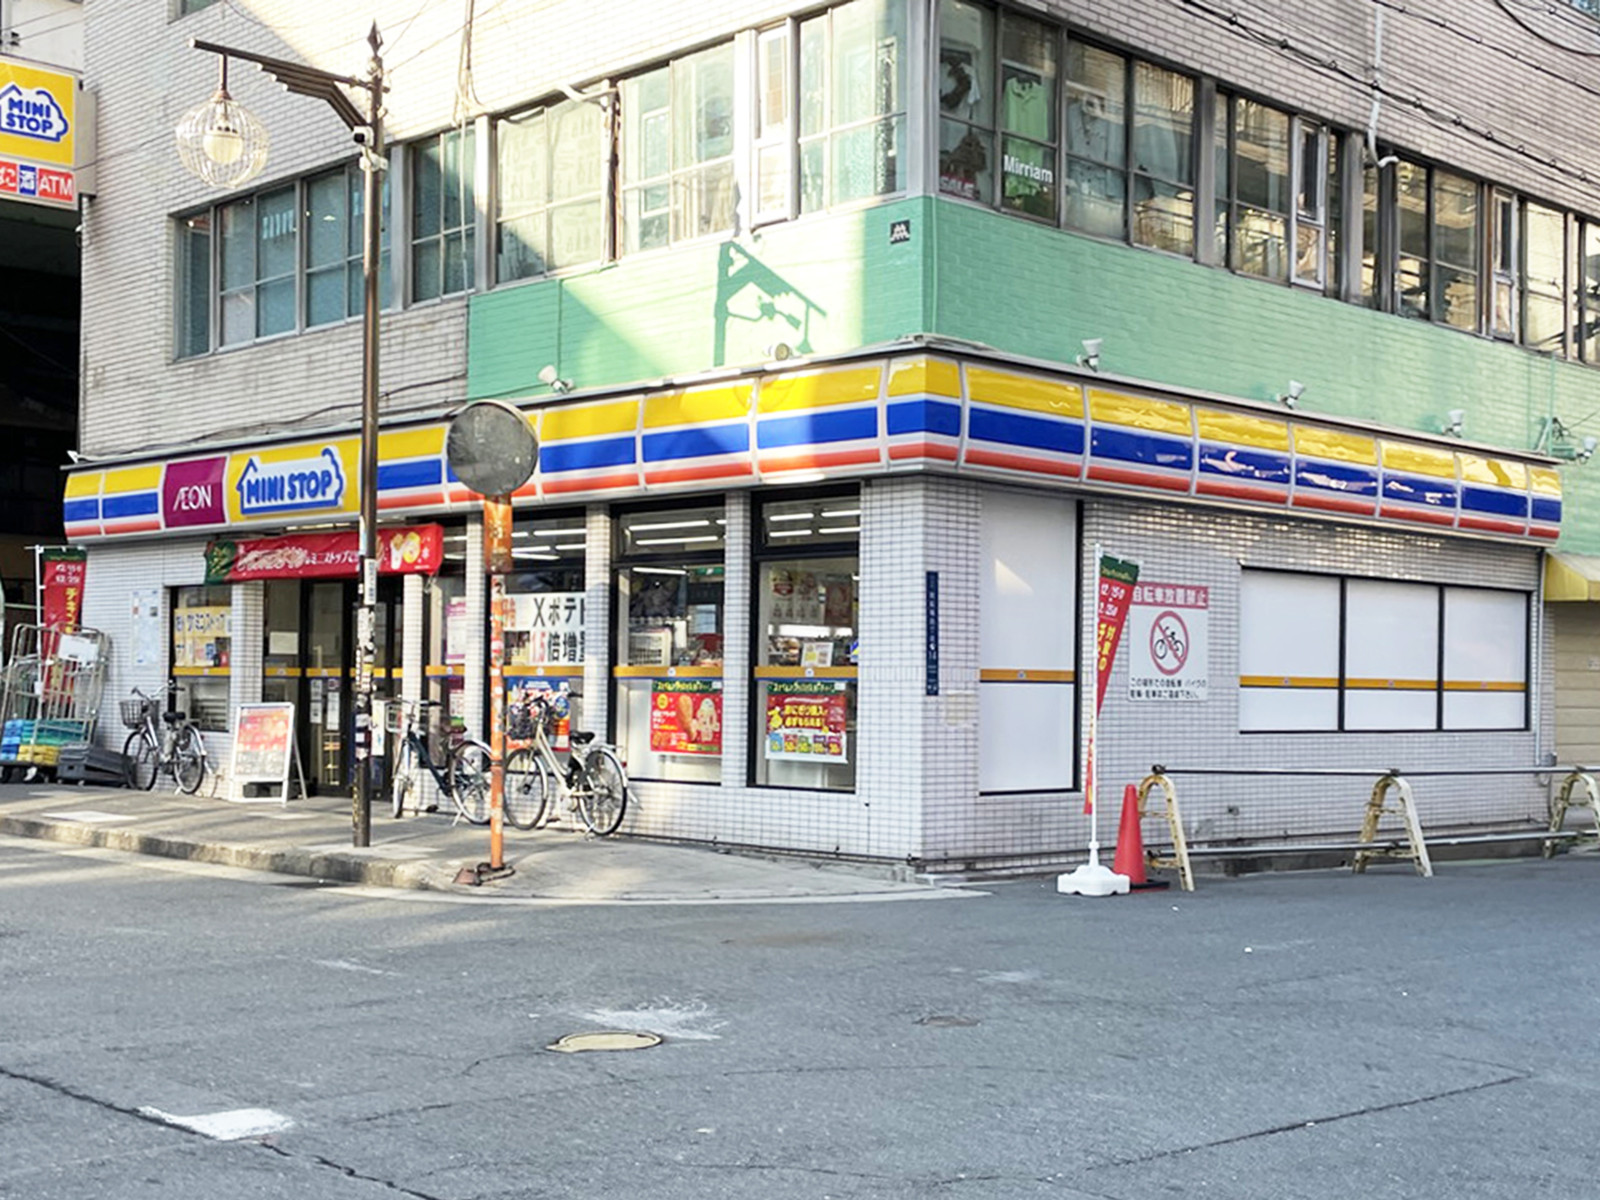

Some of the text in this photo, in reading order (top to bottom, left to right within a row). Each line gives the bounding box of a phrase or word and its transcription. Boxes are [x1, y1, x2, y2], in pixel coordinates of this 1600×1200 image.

[8, 98, 51, 118] MINI
[6, 113, 53, 133] STOP
[1003, 155, 1052, 183] Mirriam
[39, 175, 72, 195] ATM
